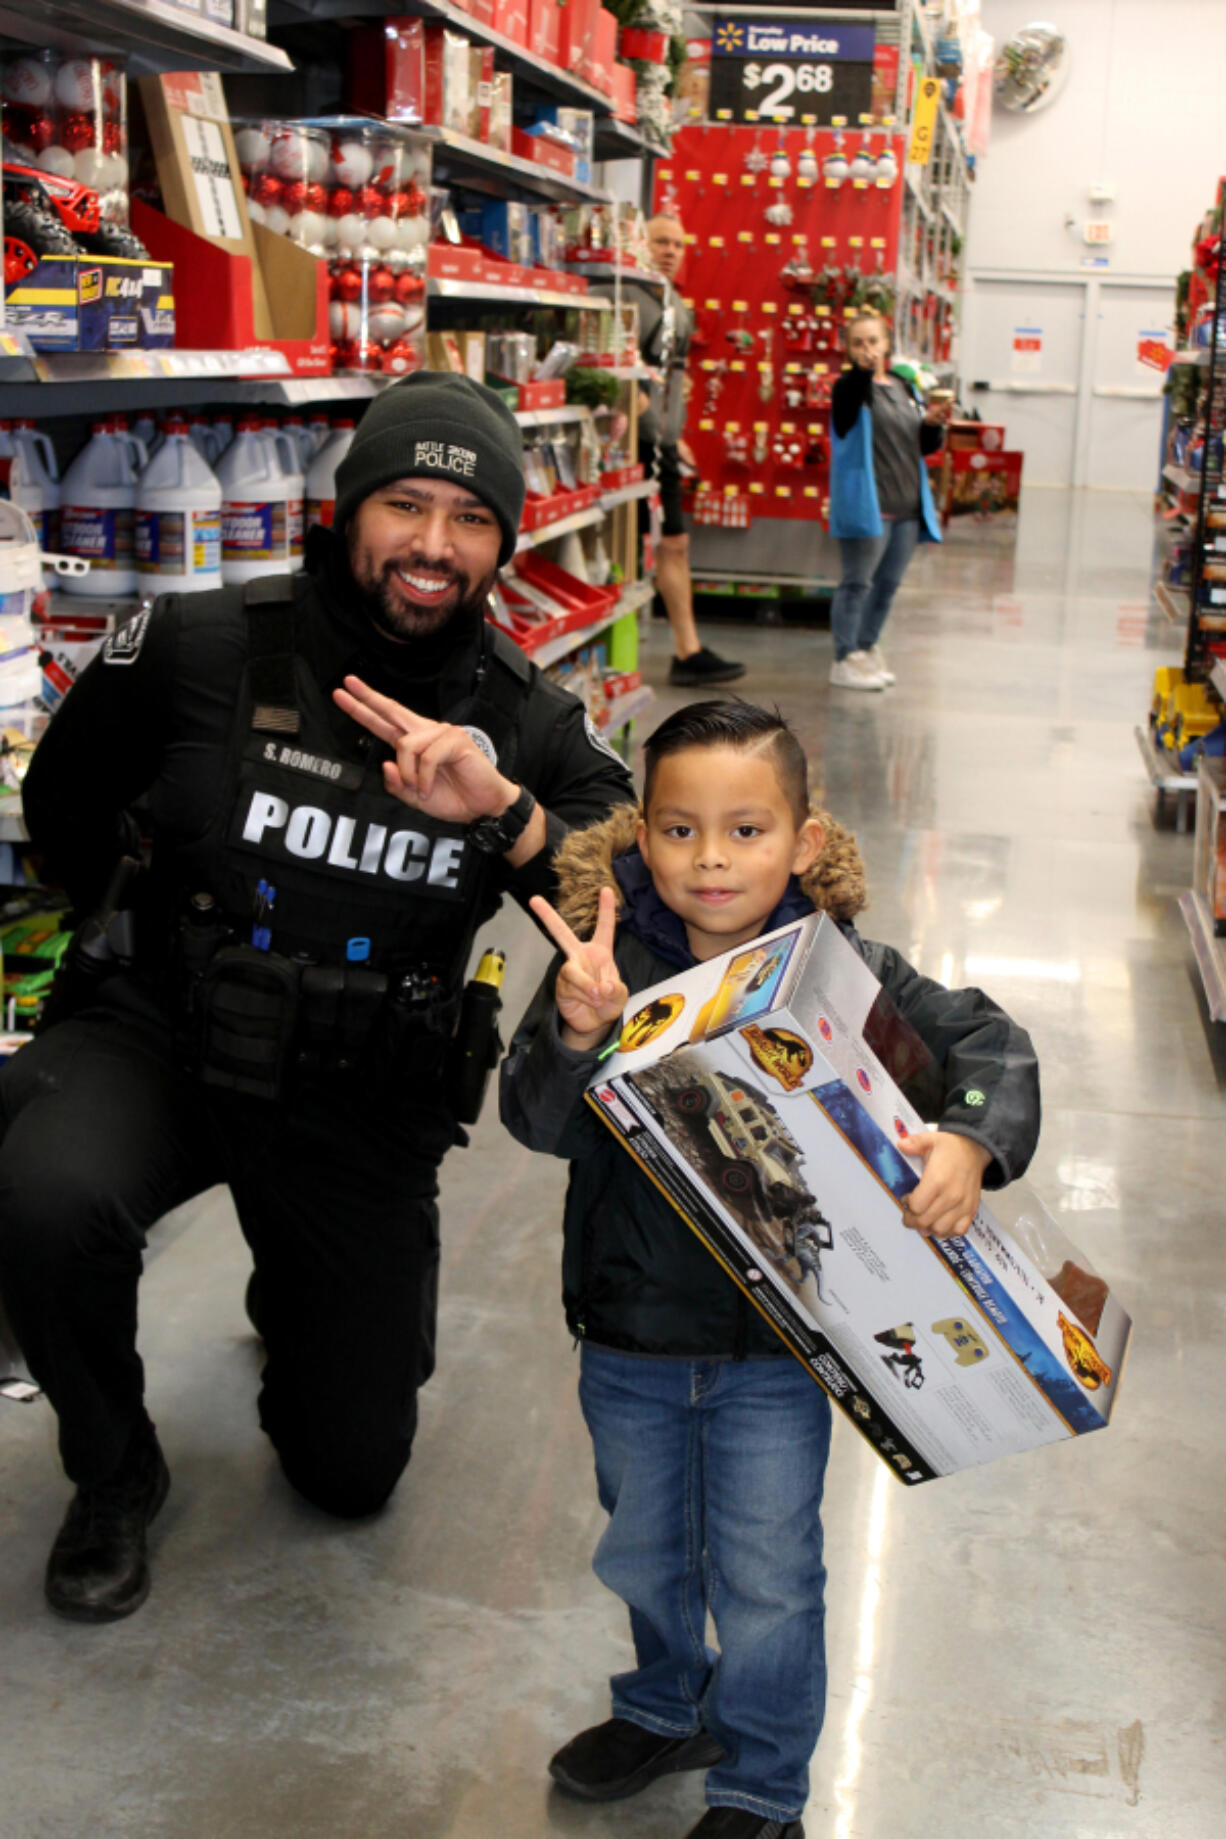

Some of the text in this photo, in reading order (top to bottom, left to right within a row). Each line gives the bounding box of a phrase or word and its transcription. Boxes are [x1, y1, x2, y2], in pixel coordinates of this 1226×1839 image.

[747, 33, 840, 54] Low Price
[414, 450, 477, 478] POLICE
[263, 741, 343, 780] S. ROMERO
[241, 790, 466, 890] POLICE
